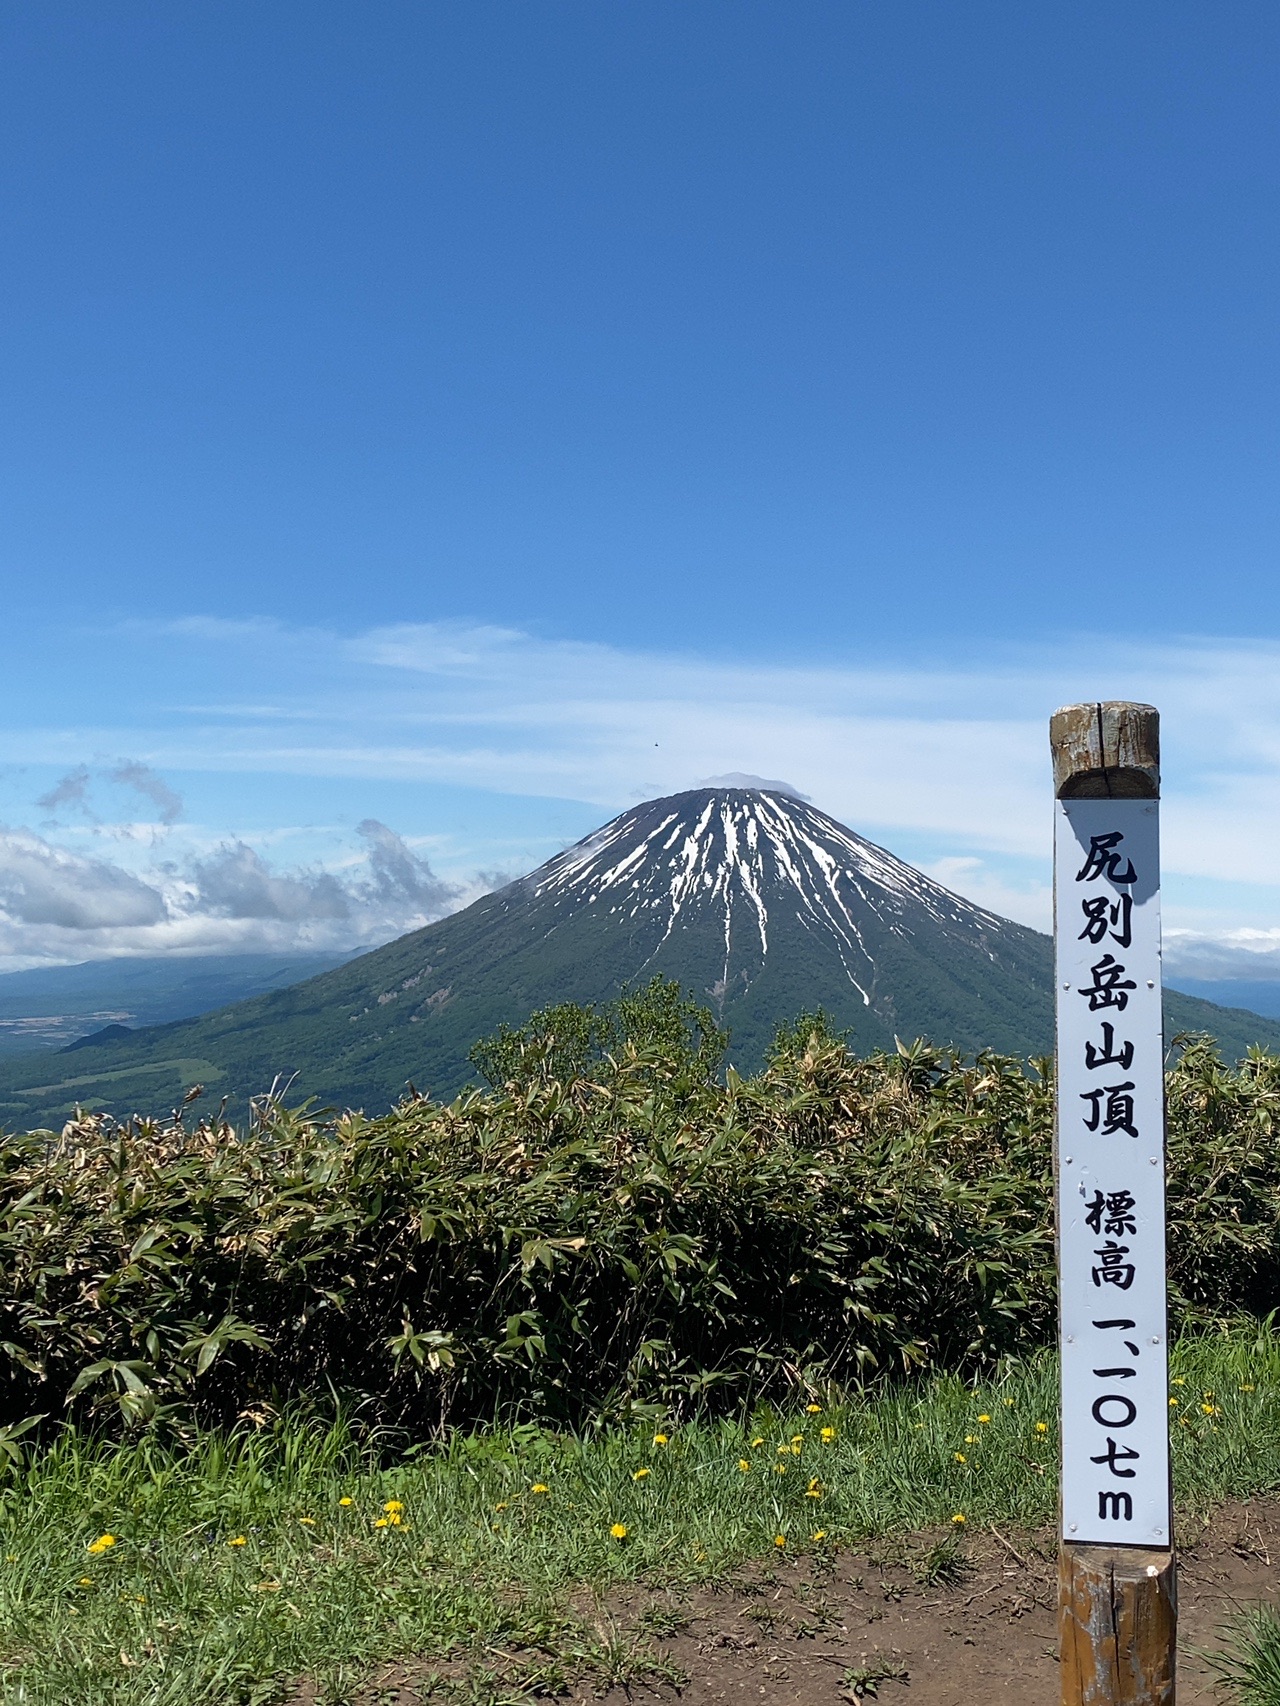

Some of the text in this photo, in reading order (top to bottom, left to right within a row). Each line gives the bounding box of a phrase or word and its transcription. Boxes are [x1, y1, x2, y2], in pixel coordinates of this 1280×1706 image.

[1075, 830, 1139, 1139] 尻別岳山頂
[1084, 1188, 1138, 1292] 標高
